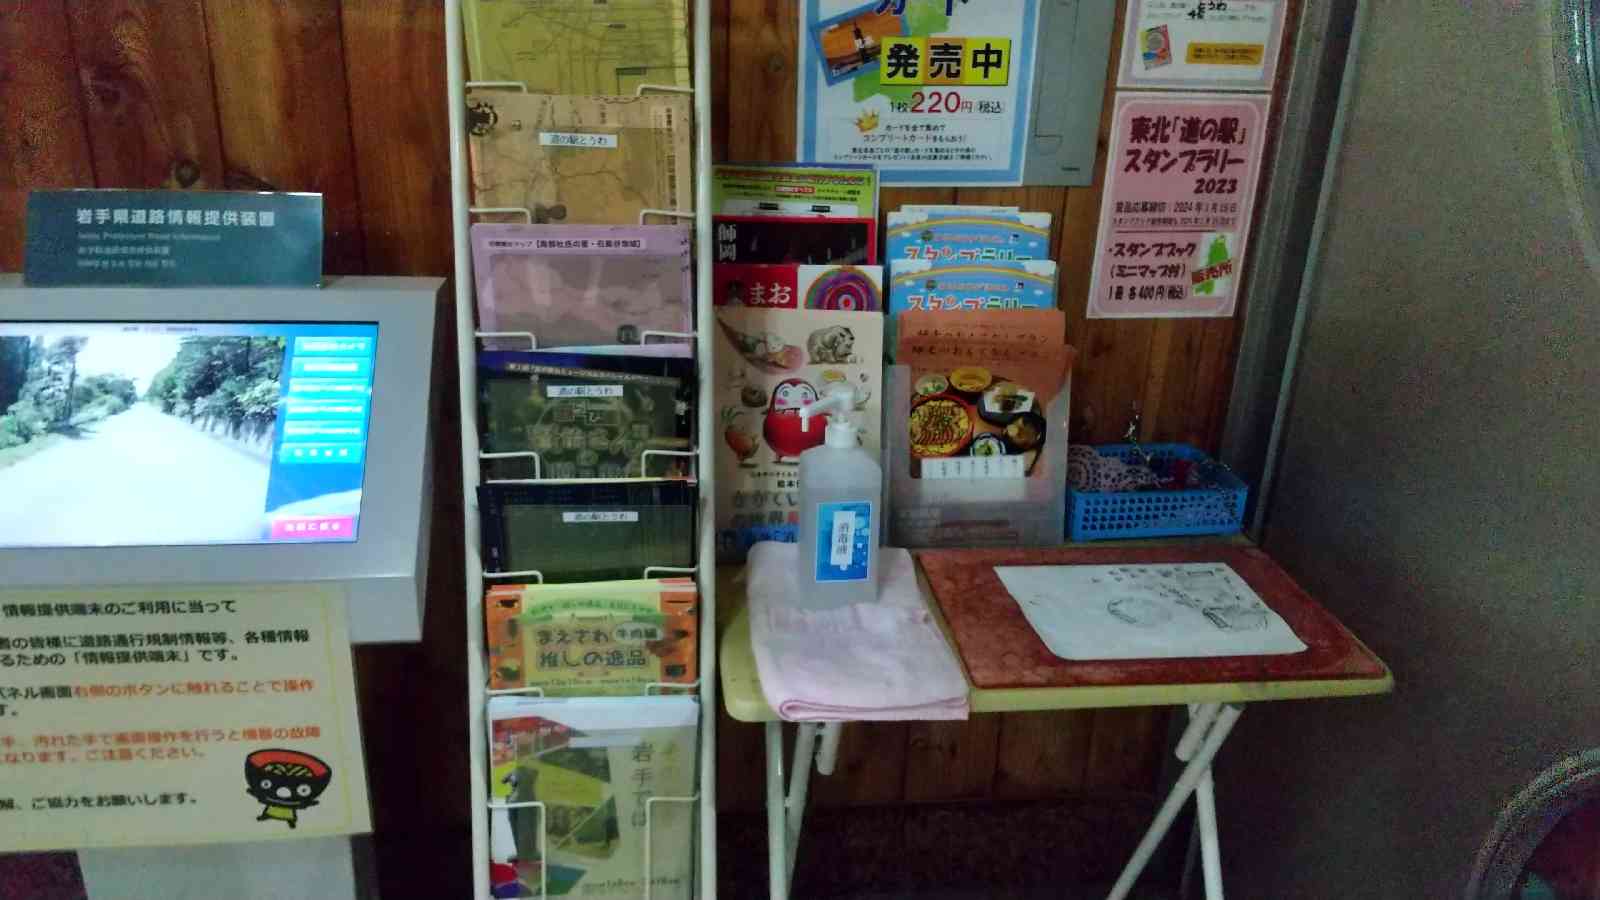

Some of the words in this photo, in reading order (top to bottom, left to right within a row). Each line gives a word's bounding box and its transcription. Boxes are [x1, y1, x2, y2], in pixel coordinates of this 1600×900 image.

[886, 43, 1003, 79] 発売中
[1130, 115, 1246, 145] 東北「道の駅」
[1124, 148, 1245, 173] スタンプラリー
[1193, 178, 1238, 194] 2023
[76, 207, 276, 228] 岩手県道路情報提供装置
[2, 599, 238, 617] 情報提供端末のご利用に当って
[0, 750, 205, 764] なります。ご注意ください。
